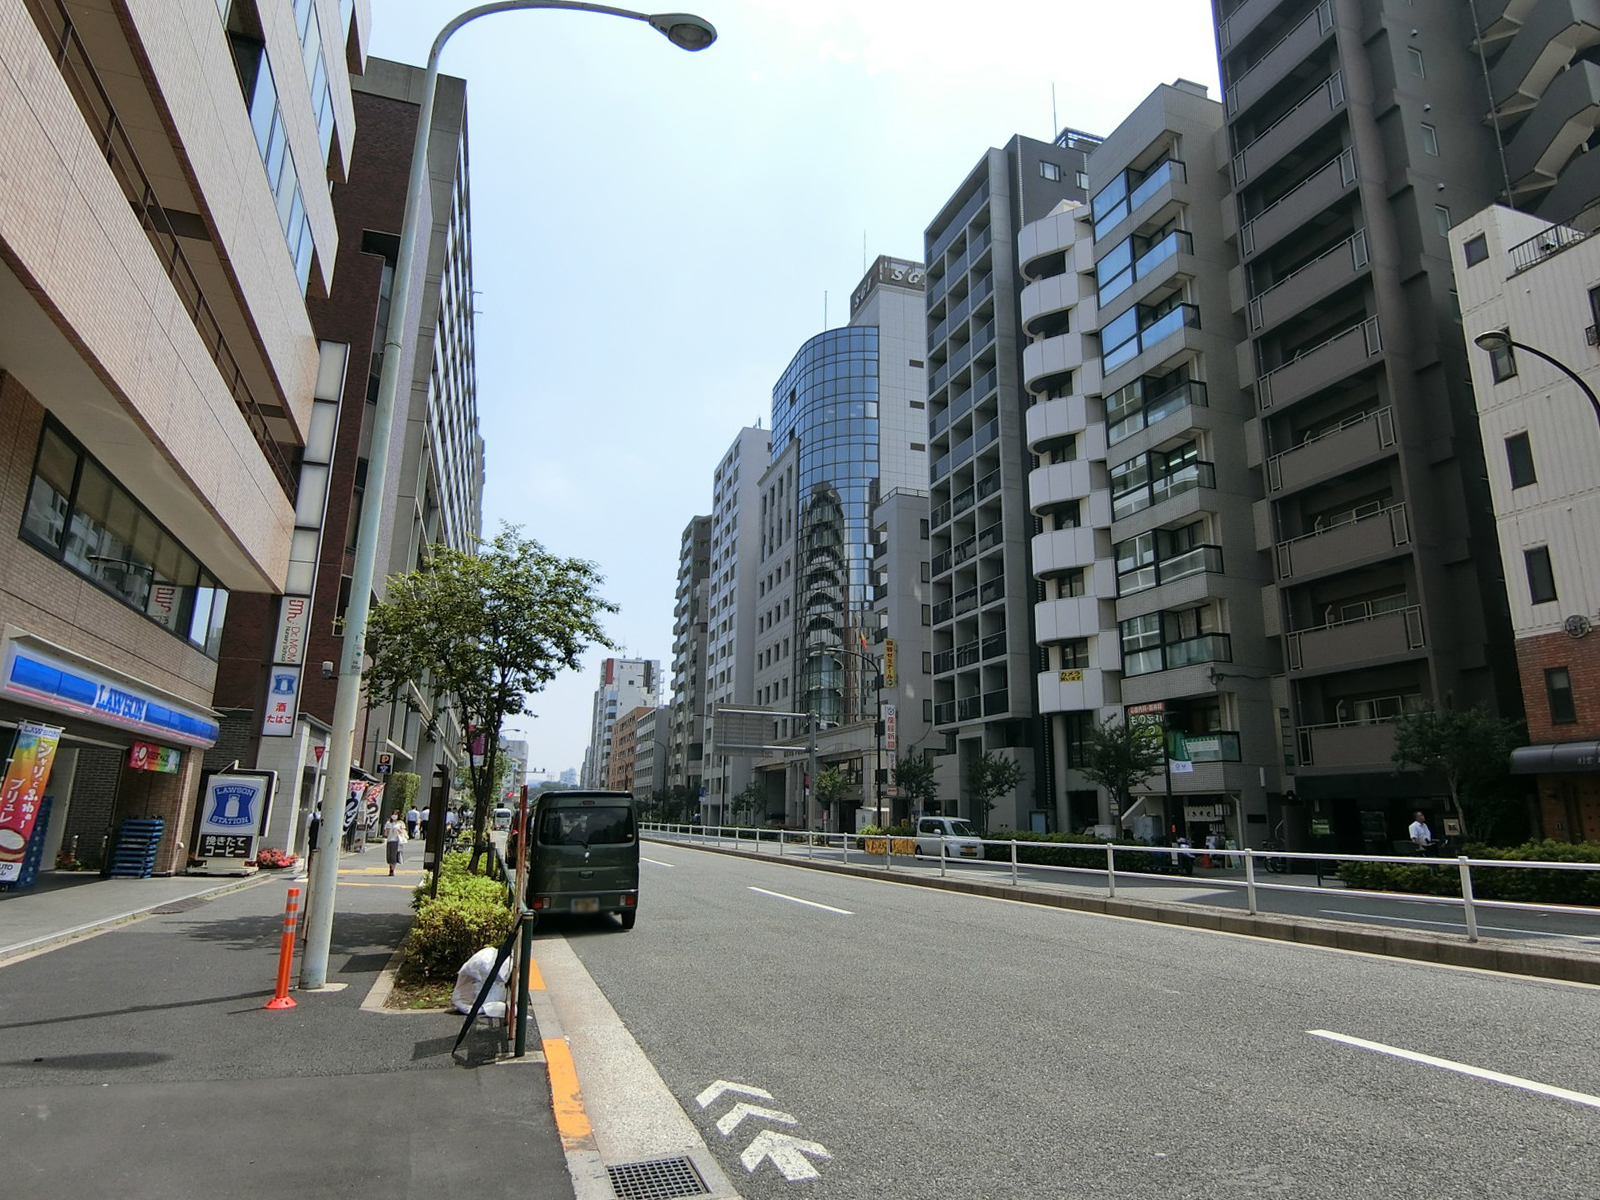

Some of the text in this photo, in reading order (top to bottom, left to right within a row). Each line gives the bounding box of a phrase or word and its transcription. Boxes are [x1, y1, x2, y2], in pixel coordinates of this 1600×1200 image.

[891, 269, 925, 286] SG
[96, 685, 146, 721] LAWSON
[276, 702, 287, 712] 酒
[266, 714, 292, 724] たばこ
[215, 786, 255, 797] LAWSON
[211, 815, 249, 825] STATION
[205, 835, 246, 846] 挽きたて
[204, 846, 246, 857] コーヒー
